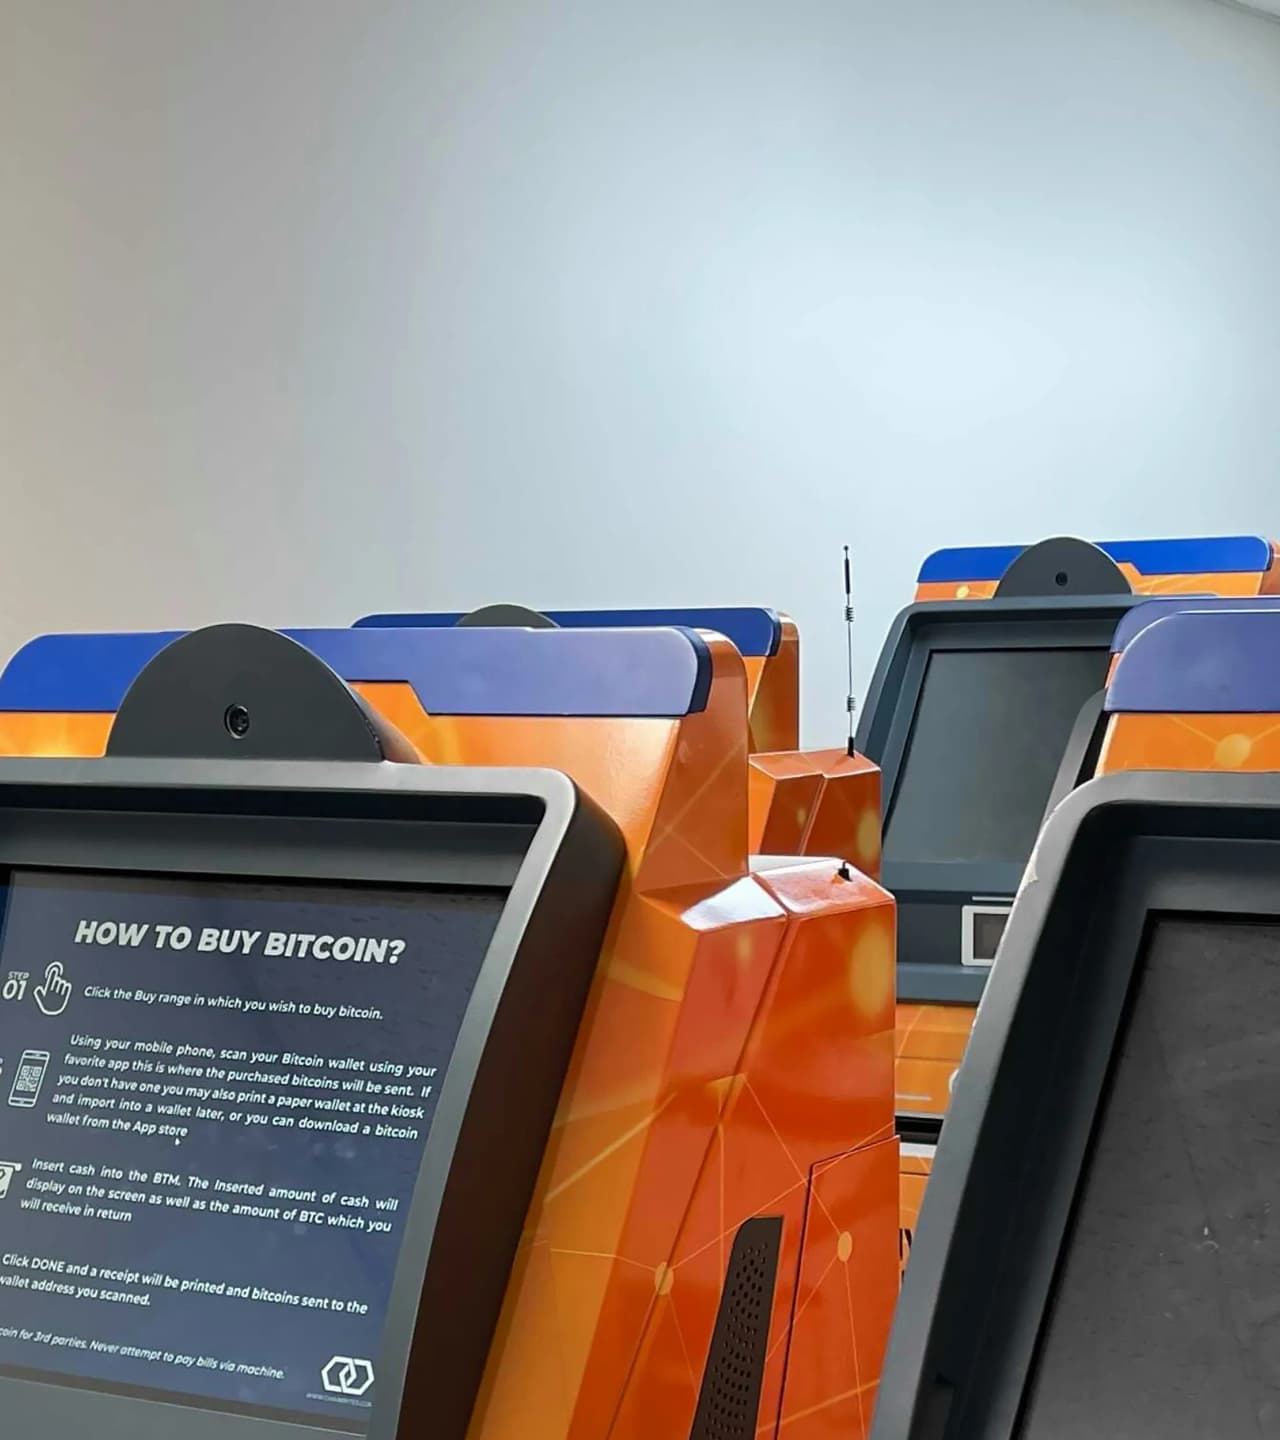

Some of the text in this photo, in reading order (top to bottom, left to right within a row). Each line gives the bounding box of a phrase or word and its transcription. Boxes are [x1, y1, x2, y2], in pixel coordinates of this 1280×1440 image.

[74, 920, 406, 964] HOW TO BUY BITCOIN?
[2, 979, 27, 1001] 01
[84, 985, 383, 1020] Click the Buy range in which you wish to buy bitcoin.
[64, 1053, 432, 1098] favorite app this is where the purchased bitcoins will be sent. If
[70, 1034, 437, 1078] Using your mobile phone, scan your Bitcoin wallet using your
[52, 1093, 418, 1140] and import into a wallet later, or you can download a bitcoin
[56, 1074, 425, 1119] you don't have one you may also print a paper wallet at the kiosk
[47, 1112, 188, 1137] wallet from the App store
[26, 1177, 392, 1233] display on the screen as well as the amount of BTC which you
[32, 1158, 399, 1211] Insert cash into the BTM. The Inserted amount of cash will
[20, 1198, 132, 1222] will receive in return
[2, 1253, 368, 1314] Click DONE and a receipt will be printed and bitcoins sent to the
[31, 1279, 75, 1295] address
[75, 1287, 99, 1299] you
[99, 1289, 151, 1306] scanned.
